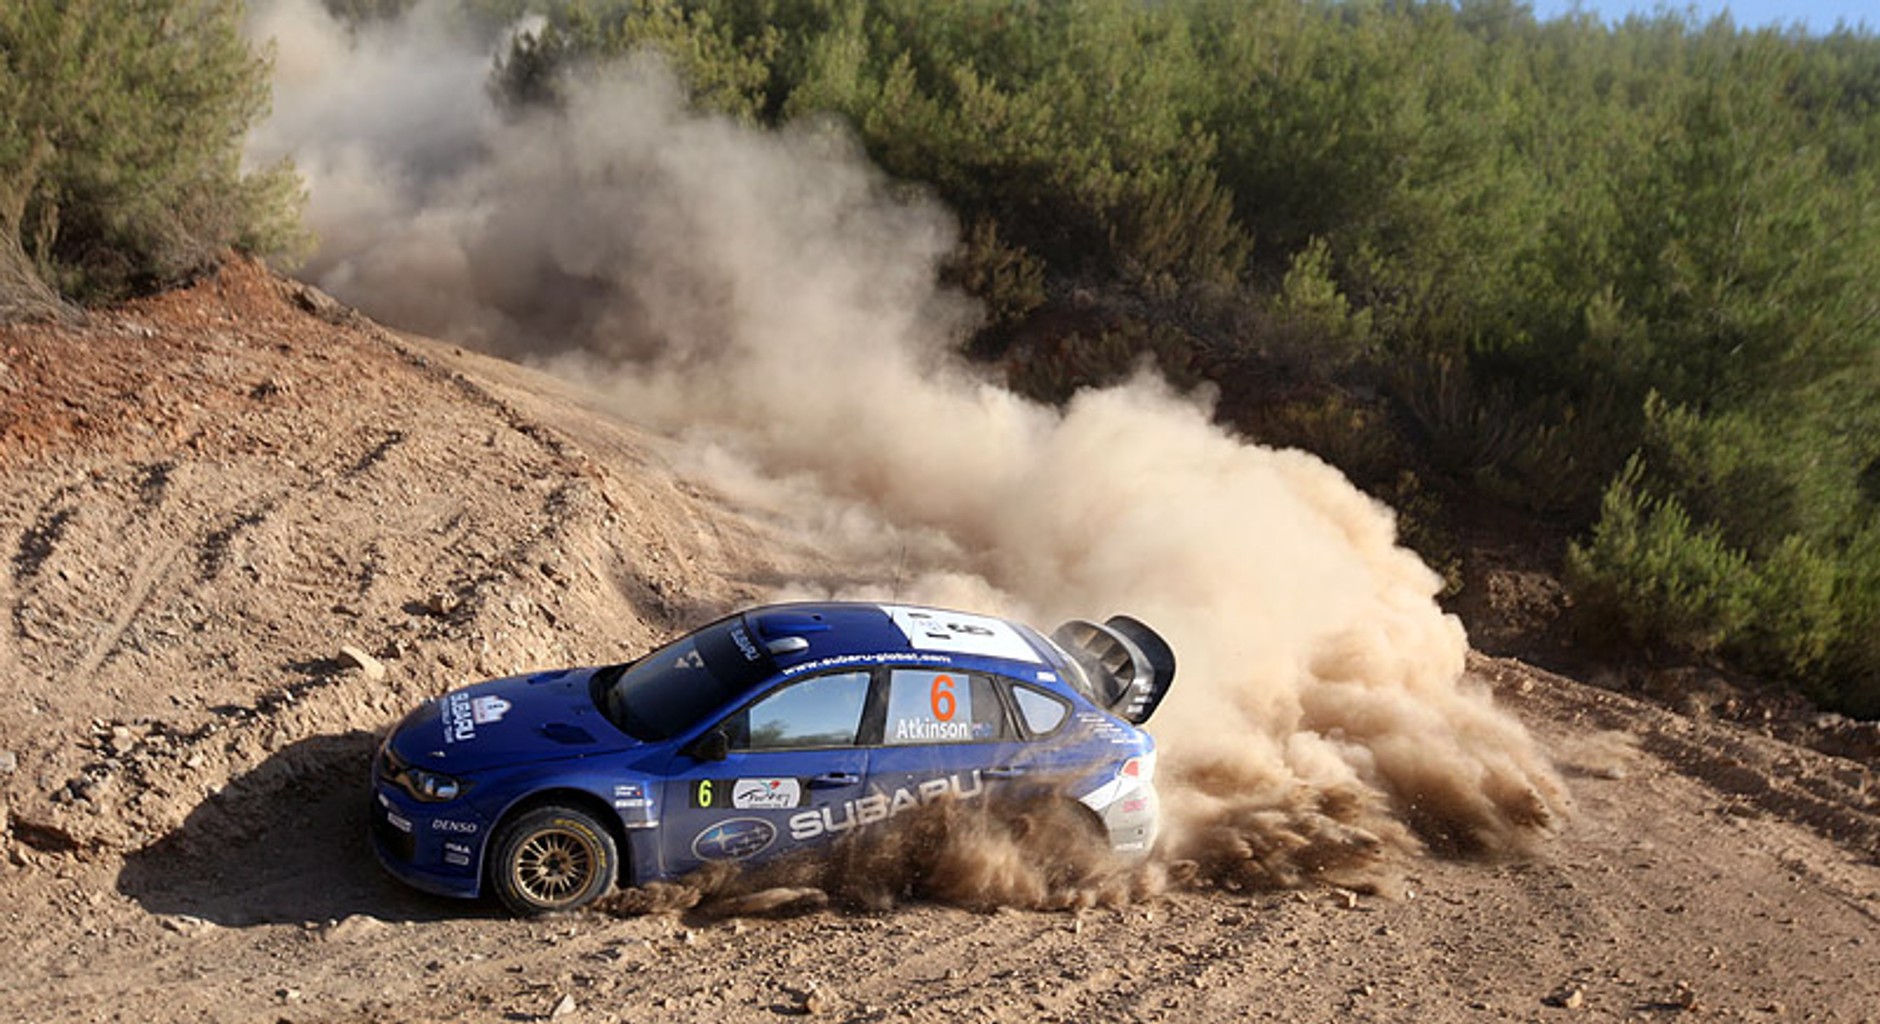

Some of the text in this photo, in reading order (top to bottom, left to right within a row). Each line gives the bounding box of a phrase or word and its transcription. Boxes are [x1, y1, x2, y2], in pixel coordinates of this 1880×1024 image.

[783, 651, 952, 676] www.subaru-global.com
[930, 674, 957, 722] 6
[450, 692, 476, 740] SUBARU
[896, 716, 968, 740] Atkinson
[699, 780, 713, 807] 6
[432, 819, 478, 834] DENSO
